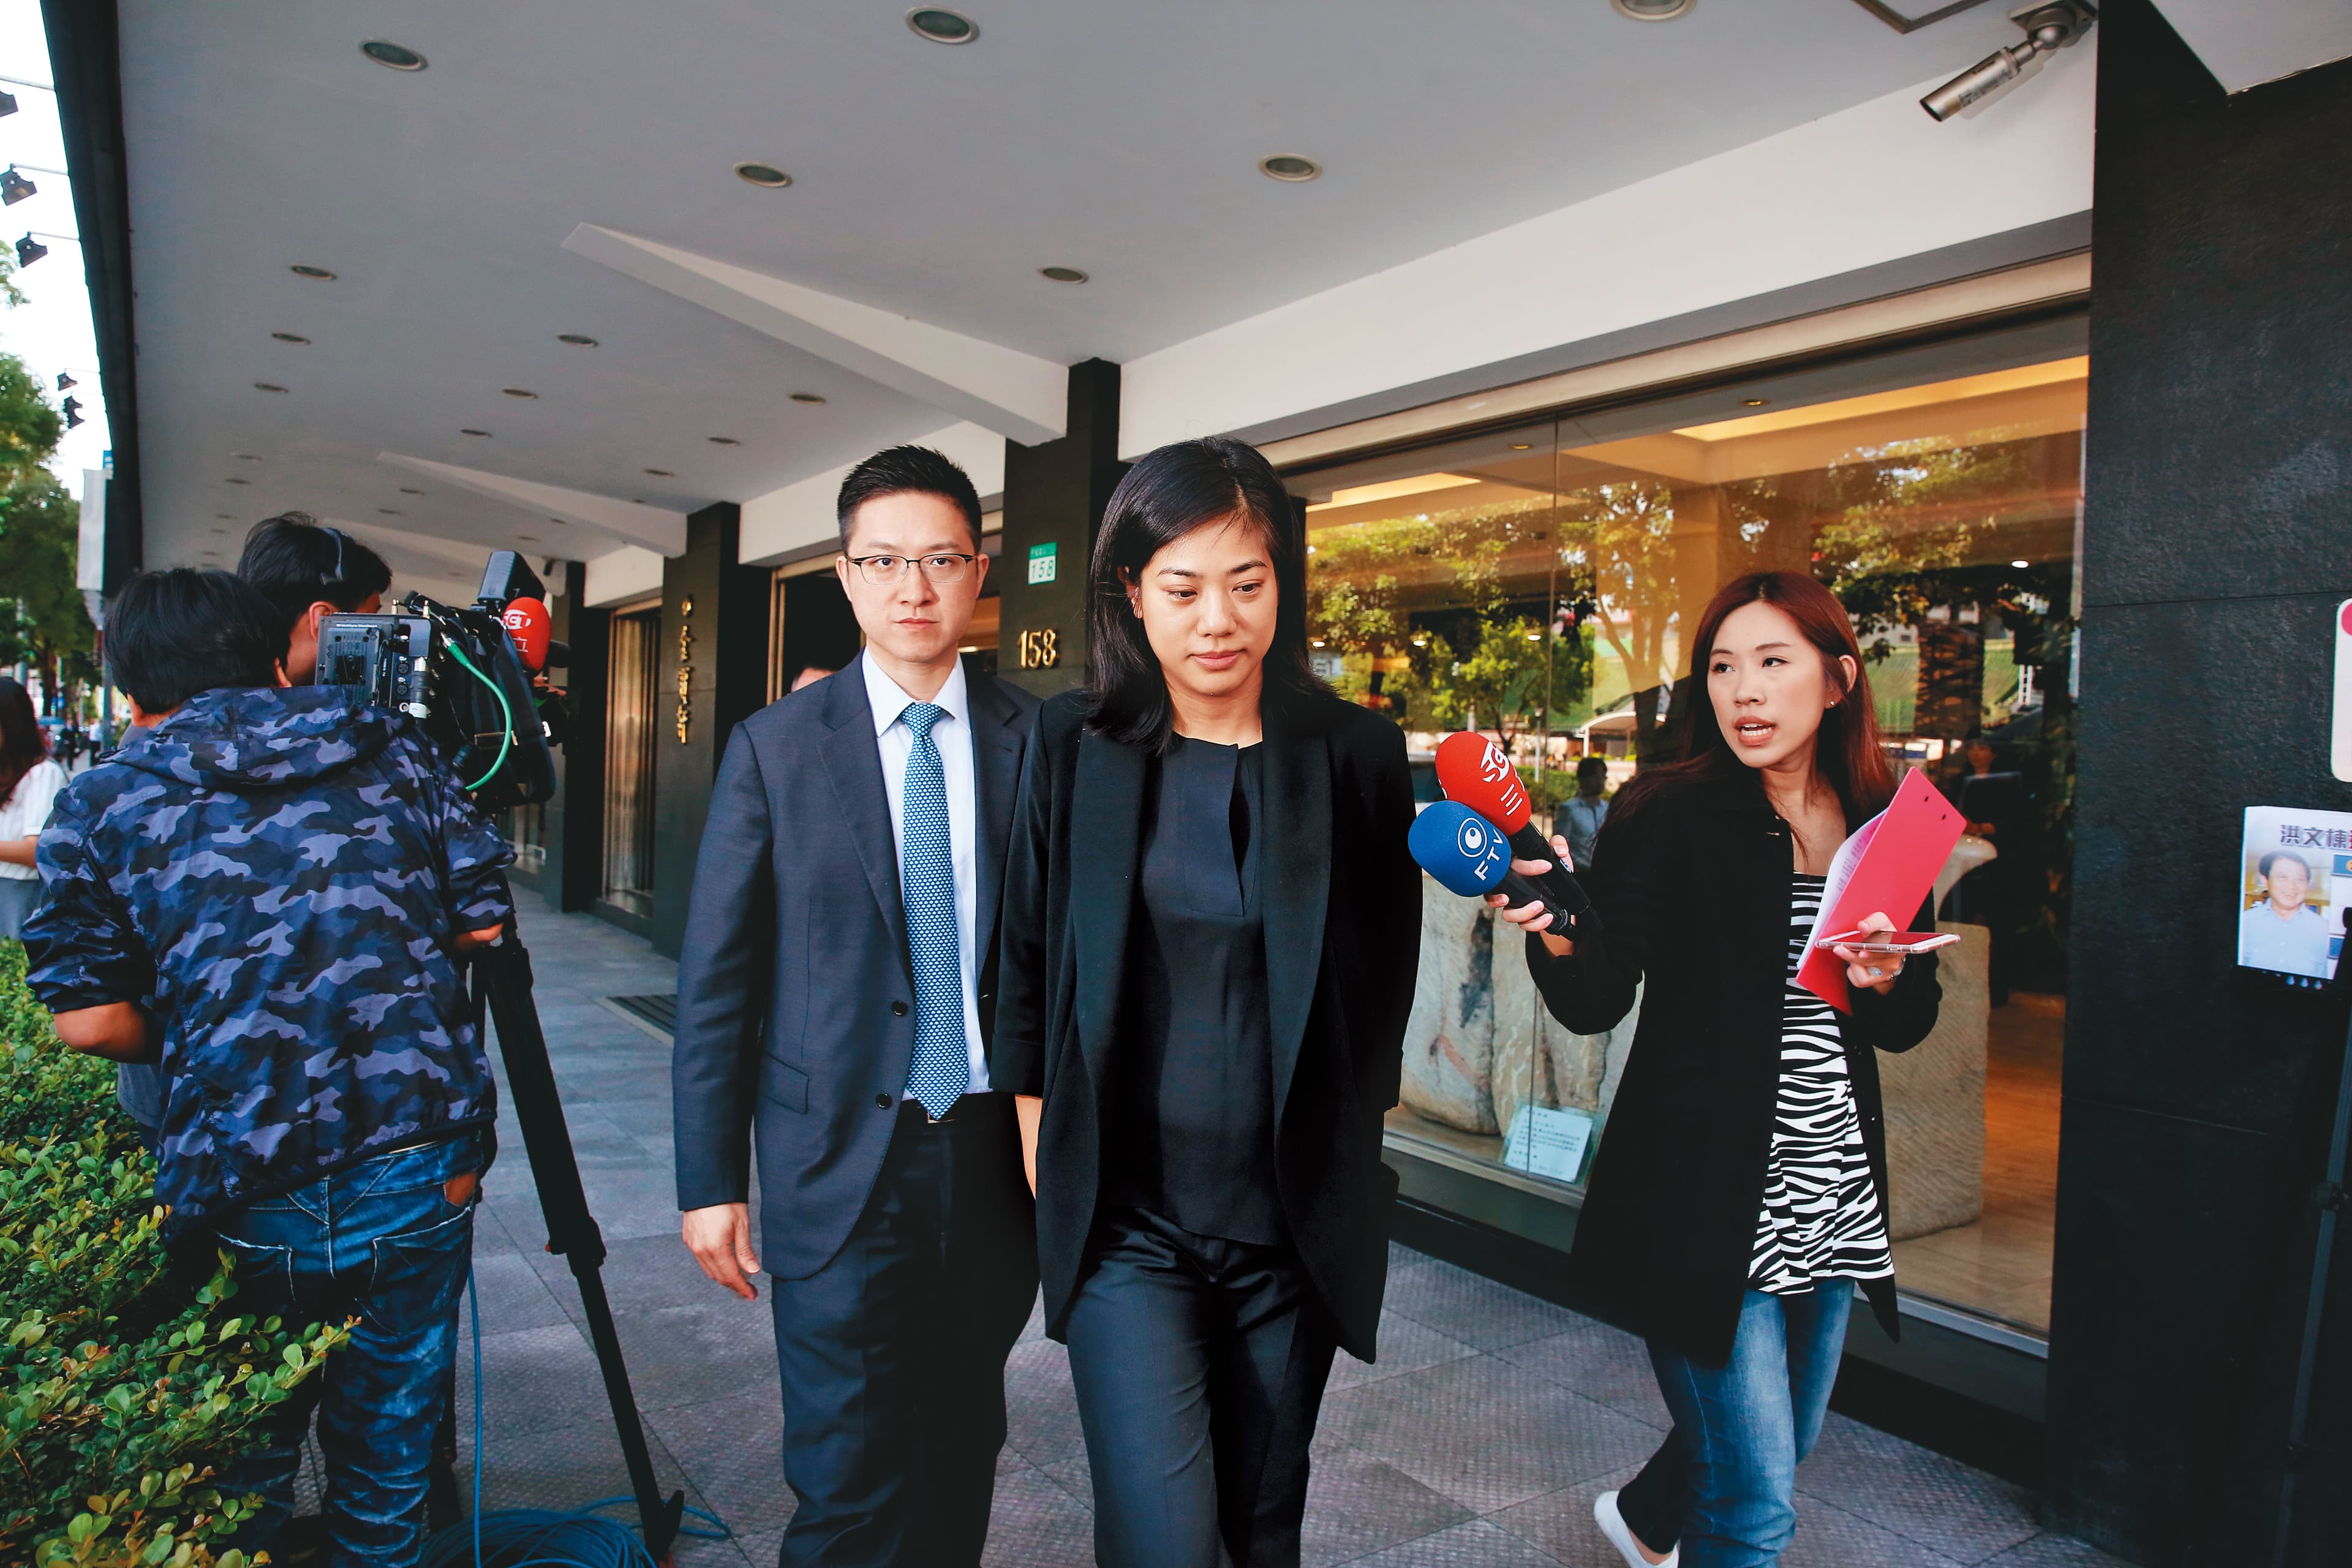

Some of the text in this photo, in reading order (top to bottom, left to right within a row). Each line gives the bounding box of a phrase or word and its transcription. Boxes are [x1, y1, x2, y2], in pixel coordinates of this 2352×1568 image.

[1031, 560, 1053, 579] 158
[1018, 629, 1056, 668] 158
[2280, 824, 2352, 848] 洪文棟
[1474, 829, 1503, 881] FTV
